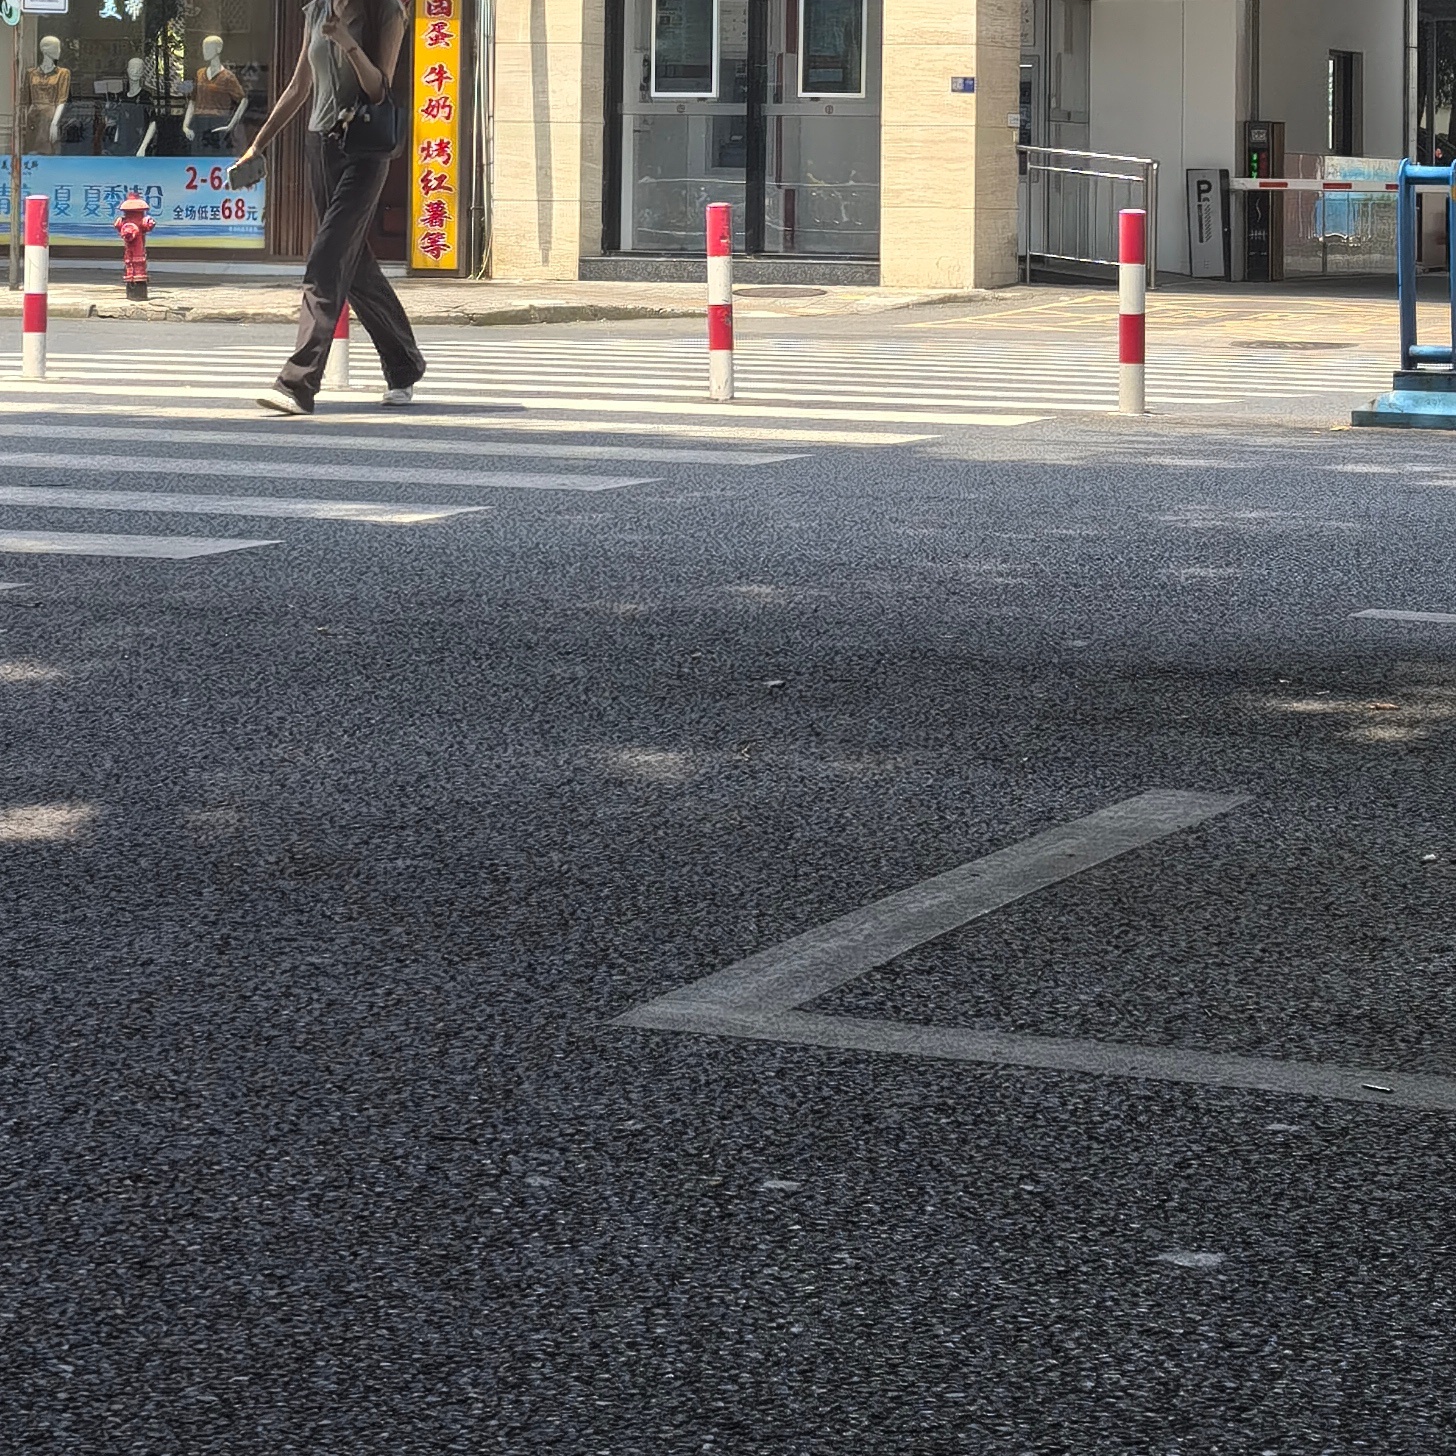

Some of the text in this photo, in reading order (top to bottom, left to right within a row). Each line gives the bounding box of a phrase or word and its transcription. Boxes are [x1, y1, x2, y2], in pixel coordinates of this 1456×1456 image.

[421, 63, 454, 122] 牛奶
[173, 198, 258, 221] 全场低至68元
[420, 137, 454, 261] 烤红薯等
